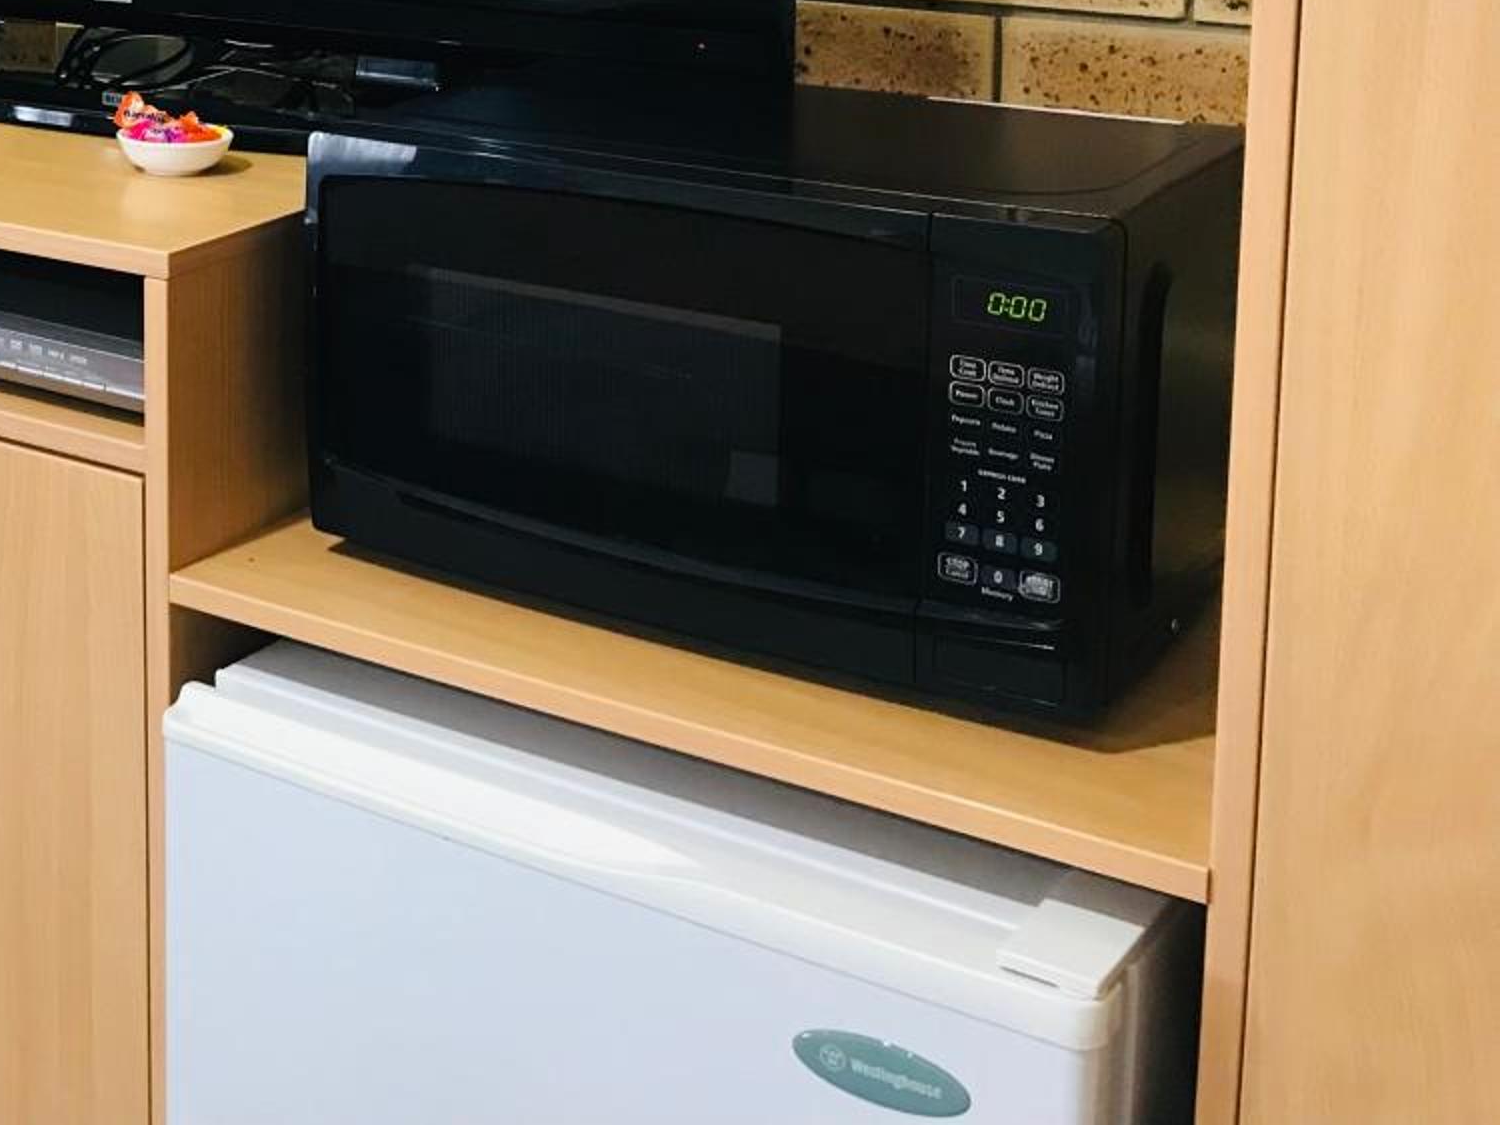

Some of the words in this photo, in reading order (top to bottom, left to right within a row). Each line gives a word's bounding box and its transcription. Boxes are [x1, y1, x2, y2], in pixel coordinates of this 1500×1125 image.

[987, 292, 1046, 322] 0:00
[961, 480, 967, 492] 1
[997, 486, 1006, 500] 2
[1036, 494, 1045, 508] 3
[958, 502, 967, 515] 4
[996, 510, 1005, 523] 5
[1035, 518, 1044, 532] 6
[957, 526, 966, 539] 7
[995, 535, 1004, 547] 8
[1034, 542, 1043, 556] 9
[993, 570, 1003, 584] 0
